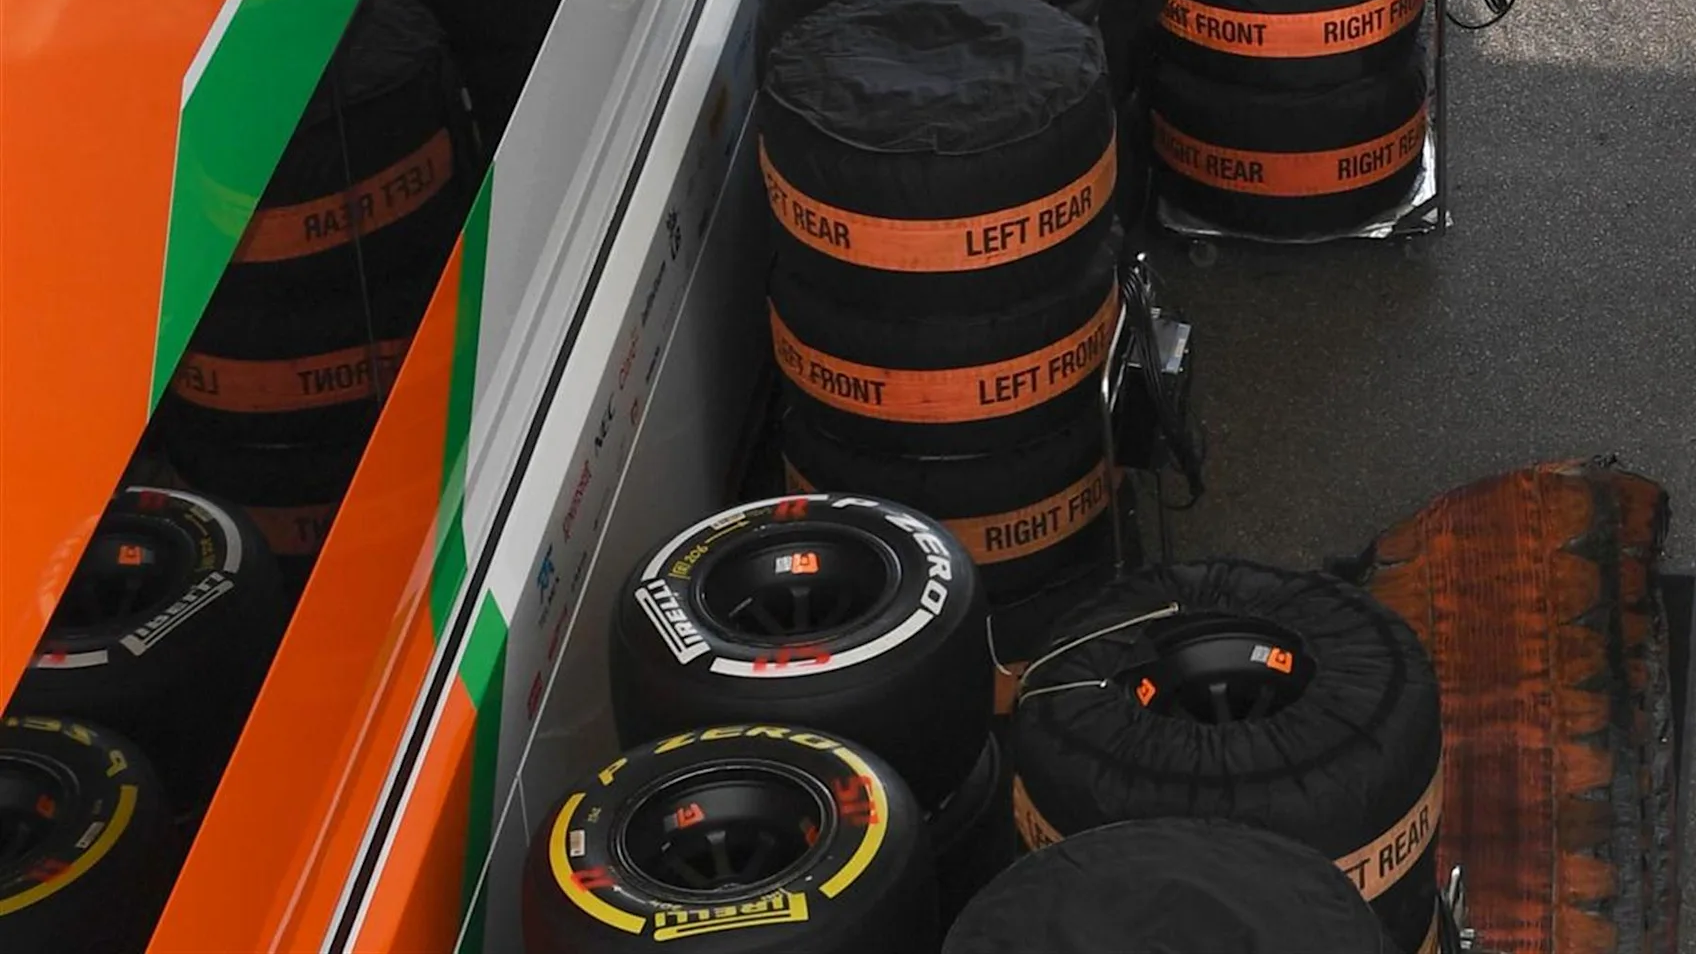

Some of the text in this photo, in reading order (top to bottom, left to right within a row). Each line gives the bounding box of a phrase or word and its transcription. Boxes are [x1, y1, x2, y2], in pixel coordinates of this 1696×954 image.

[1195, 13, 1267, 46] FRONT
[1323, 6, 1385, 45] RIGHT
[1206, 153, 1264, 183] REAR
[1337, 143, 1394, 180] RIGHT
[792, 200, 850, 249] REAR
[965, 185, 1092, 257] LEFT REAR
[810, 361, 886, 406] FRONT
[978, 321, 1109, 406] LEFT FRONT
[985, 512, 1062, 552] RIGHT
[885, 512, 953, 615] ZERO
[634, 579, 713, 665] PIRELLI
[598, 724, 837, 787] P ZERO
[1379, 804, 1430, 879] REAR
[653, 889, 809, 942] PIRELLI
